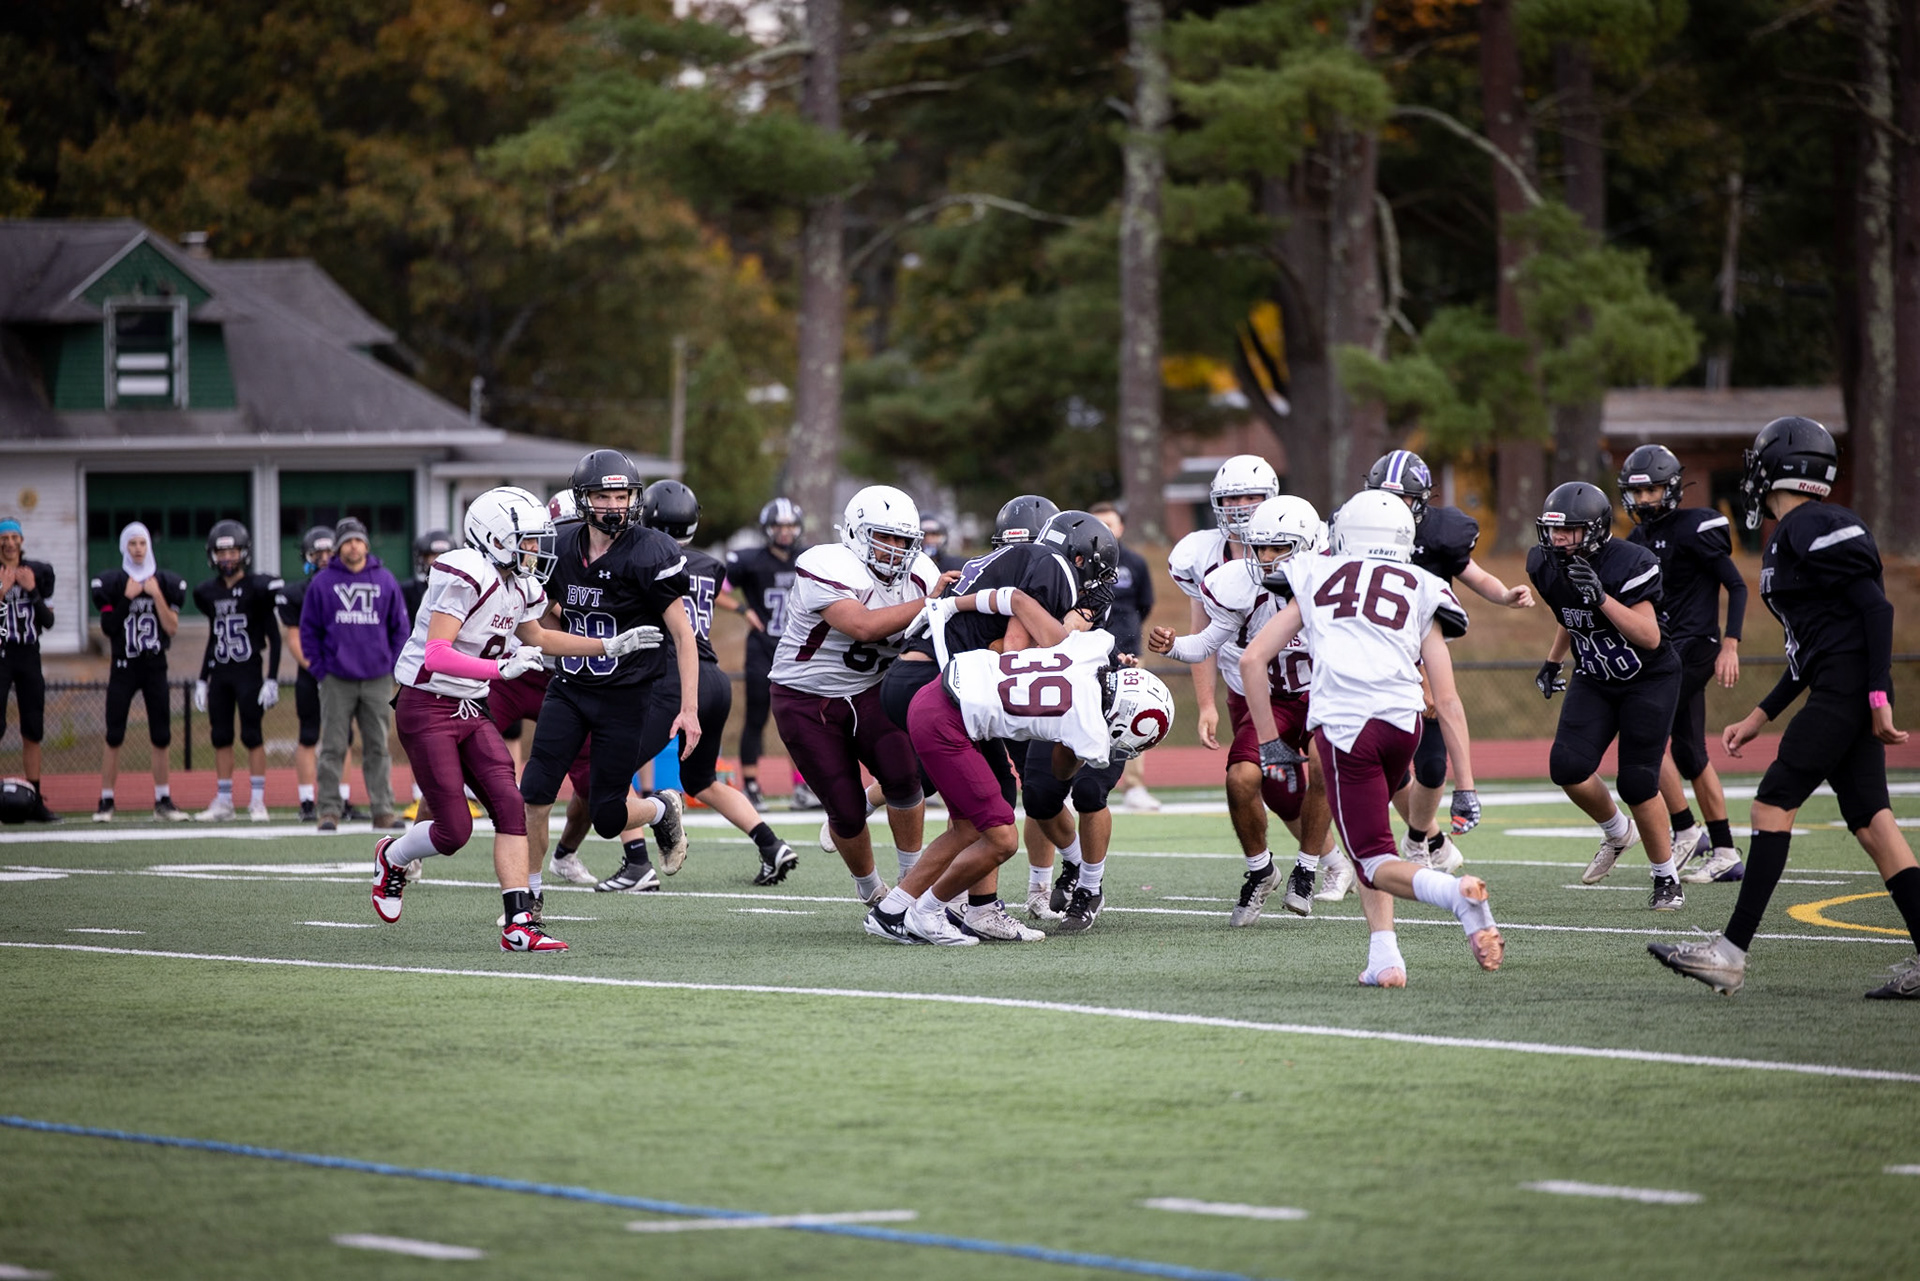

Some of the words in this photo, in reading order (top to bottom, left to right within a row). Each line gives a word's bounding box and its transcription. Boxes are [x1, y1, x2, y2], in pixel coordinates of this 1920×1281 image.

[333, 582, 381, 613] VT
[567, 584, 603, 607] BVT
[1313, 561, 1418, 631] 46
[1562, 607, 1595, 628] BVT
[124, 612, 161, 658] 12
[214, 613, 252, 664] 35
[998, 653, 1073, 717] 39
